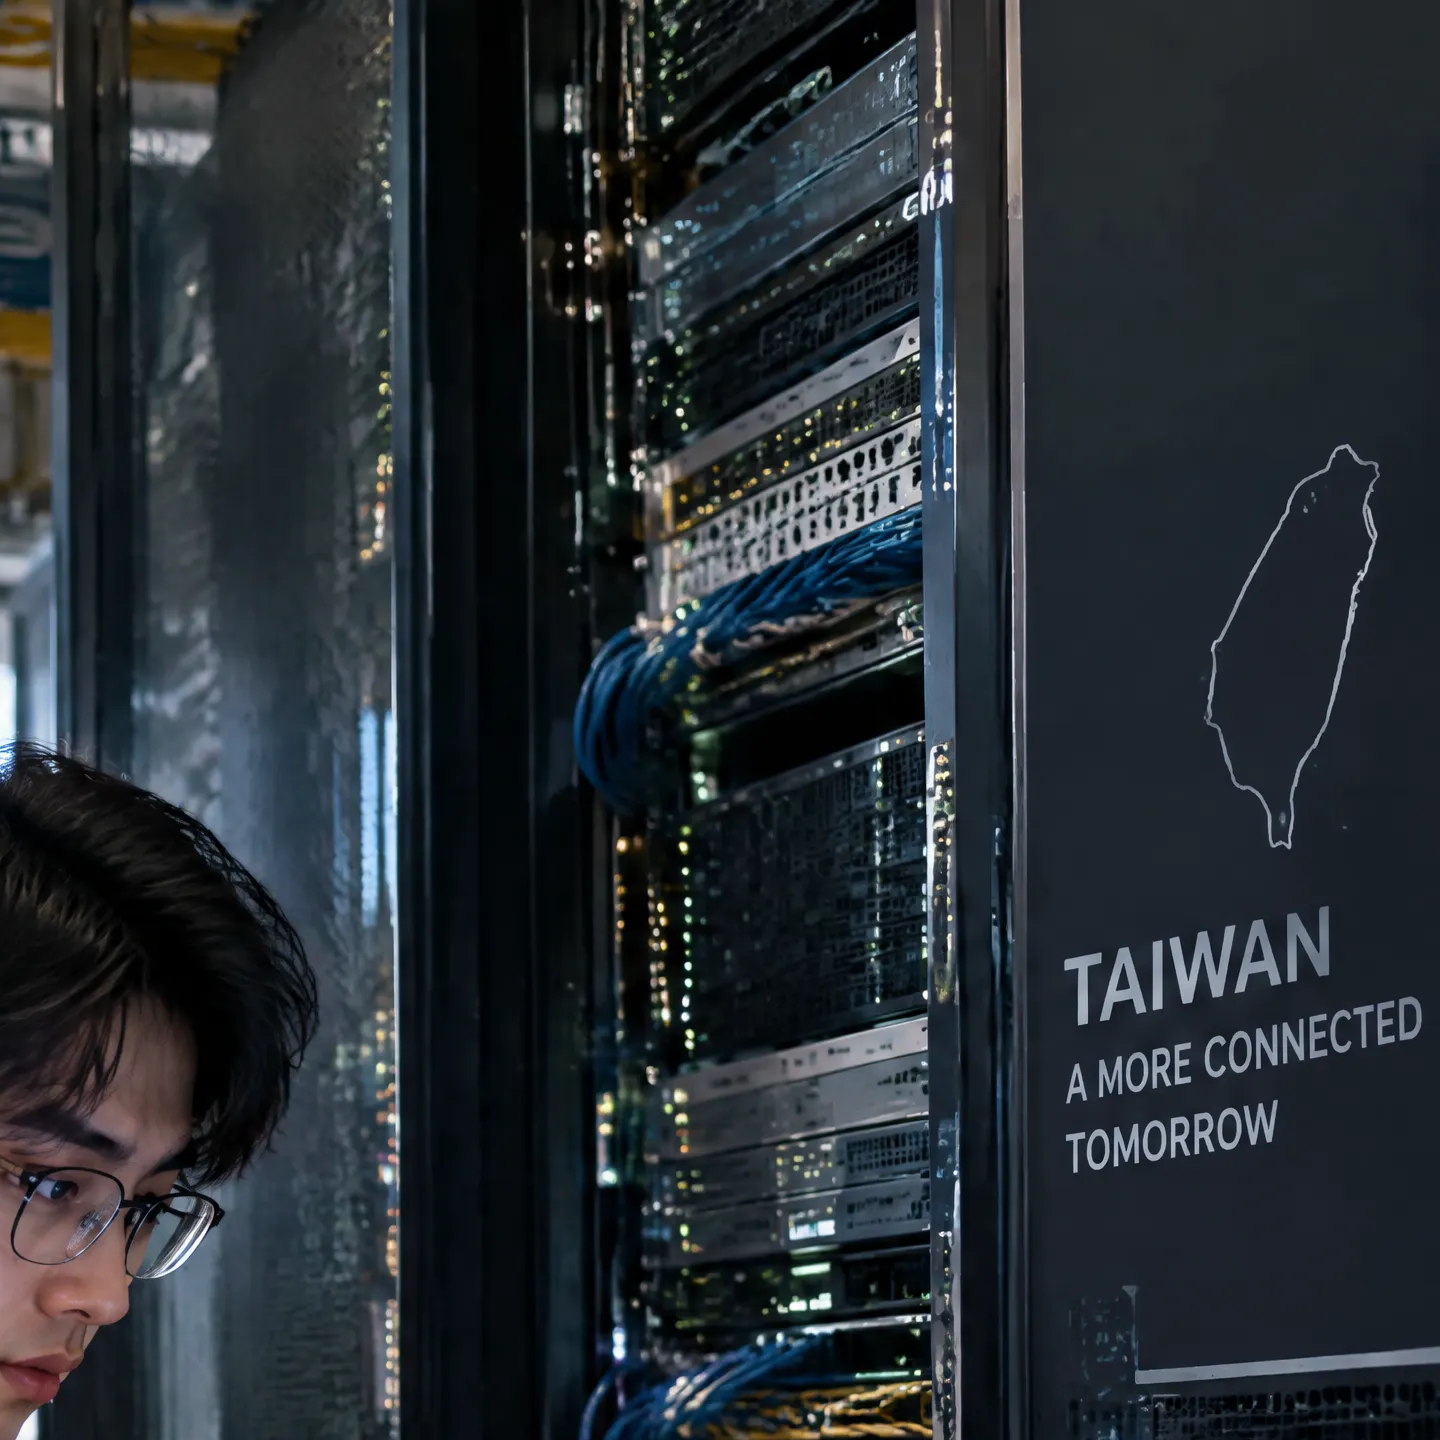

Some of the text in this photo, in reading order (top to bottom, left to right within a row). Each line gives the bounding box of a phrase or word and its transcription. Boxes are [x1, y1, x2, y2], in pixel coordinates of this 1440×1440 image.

[1064, 906, 1330, 1026] TAIWAN
[1066, 996, 1423, 1104] A MORE CONNECTED
[1065, 1100, 1279, 1174] TOMORROW
